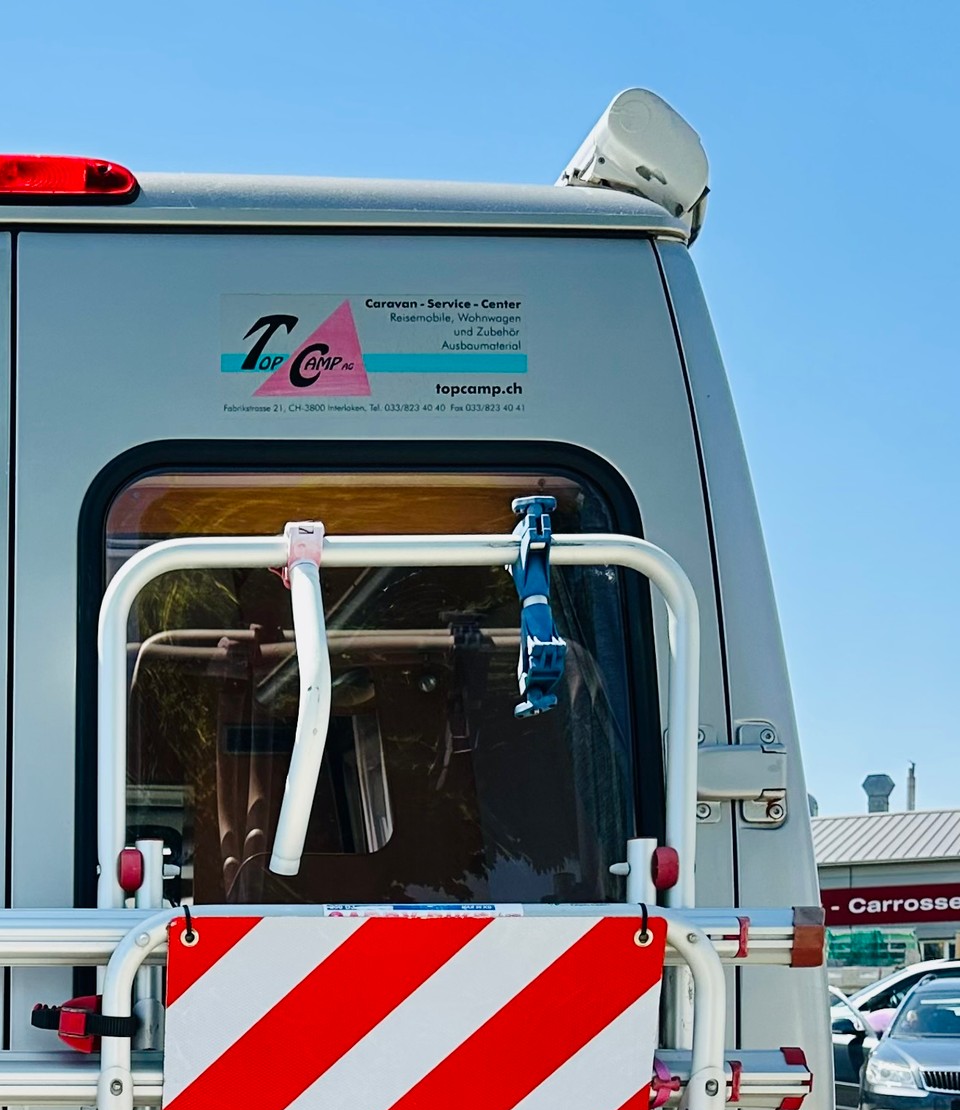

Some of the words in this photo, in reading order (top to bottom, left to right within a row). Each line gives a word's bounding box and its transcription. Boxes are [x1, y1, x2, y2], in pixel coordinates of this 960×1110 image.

[365, 299, 417, 309] Caravan
[427, 299, 471, 309] Service
[481, 299, 522, 309] Center
[390, 313, 454, 324] Reisemobile,
[457, 313, 521, 325] Wohnwagen
[453, 326, 473, 337] und
[476, 326, 520, 337] Zubehör
[441, 340, 521, 350] Ausbaumaterial
[435, 382, 523, 397] topcamp.ch
[223, 404, 271, 412] Fabrikstrasse
[288, 404, 326, 412] CH-3800
[384, 403, 420, 412] 033/823
[422, 403, 433, 412] 40
[435, 403, 446, 412] 40
[450, 403, 464, 412] Fax
[465, 403, 501, 412] 033/823
[503, 403, 514, 412] 40
[515, 403, 525, 412] 41
[848, 896, 960, 914] Carrosse
